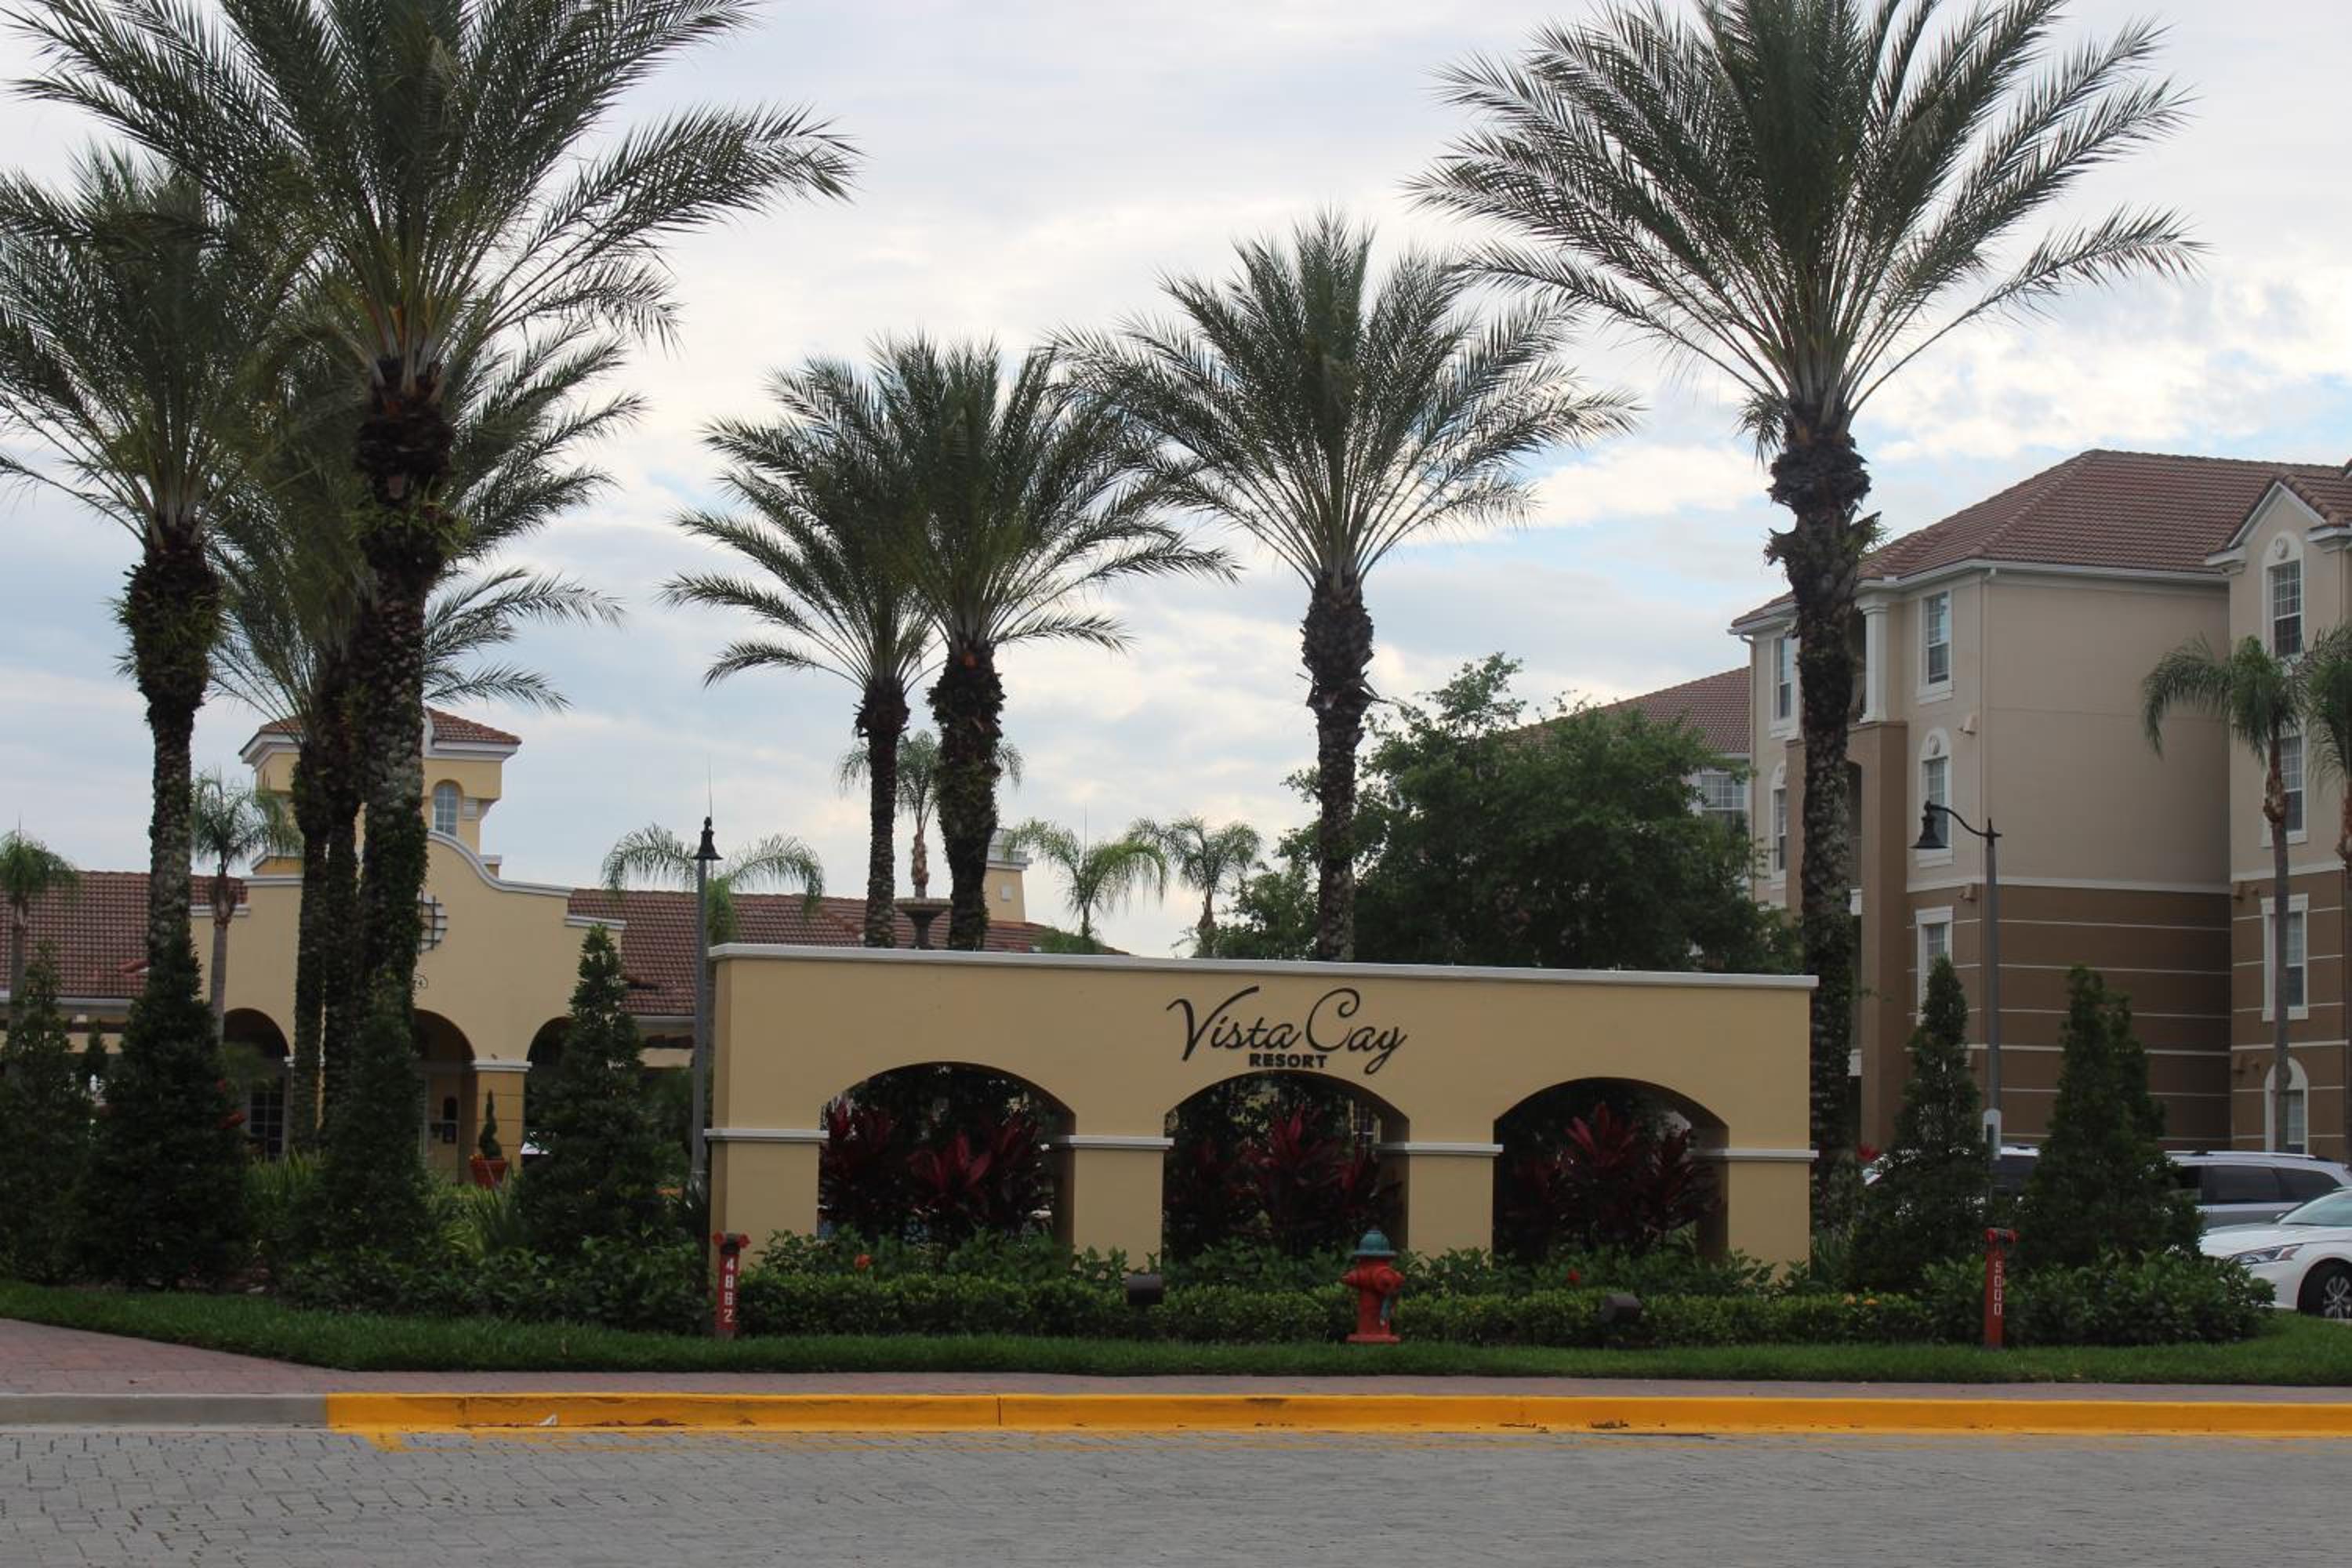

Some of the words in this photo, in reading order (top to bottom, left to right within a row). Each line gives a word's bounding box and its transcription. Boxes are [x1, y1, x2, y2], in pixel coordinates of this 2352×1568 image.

[1167, 985, 1301, 1061] Vista
[1305, 988, 1408, 1075] Cay
[1249, 1053, 1327, 1068] RESORT
